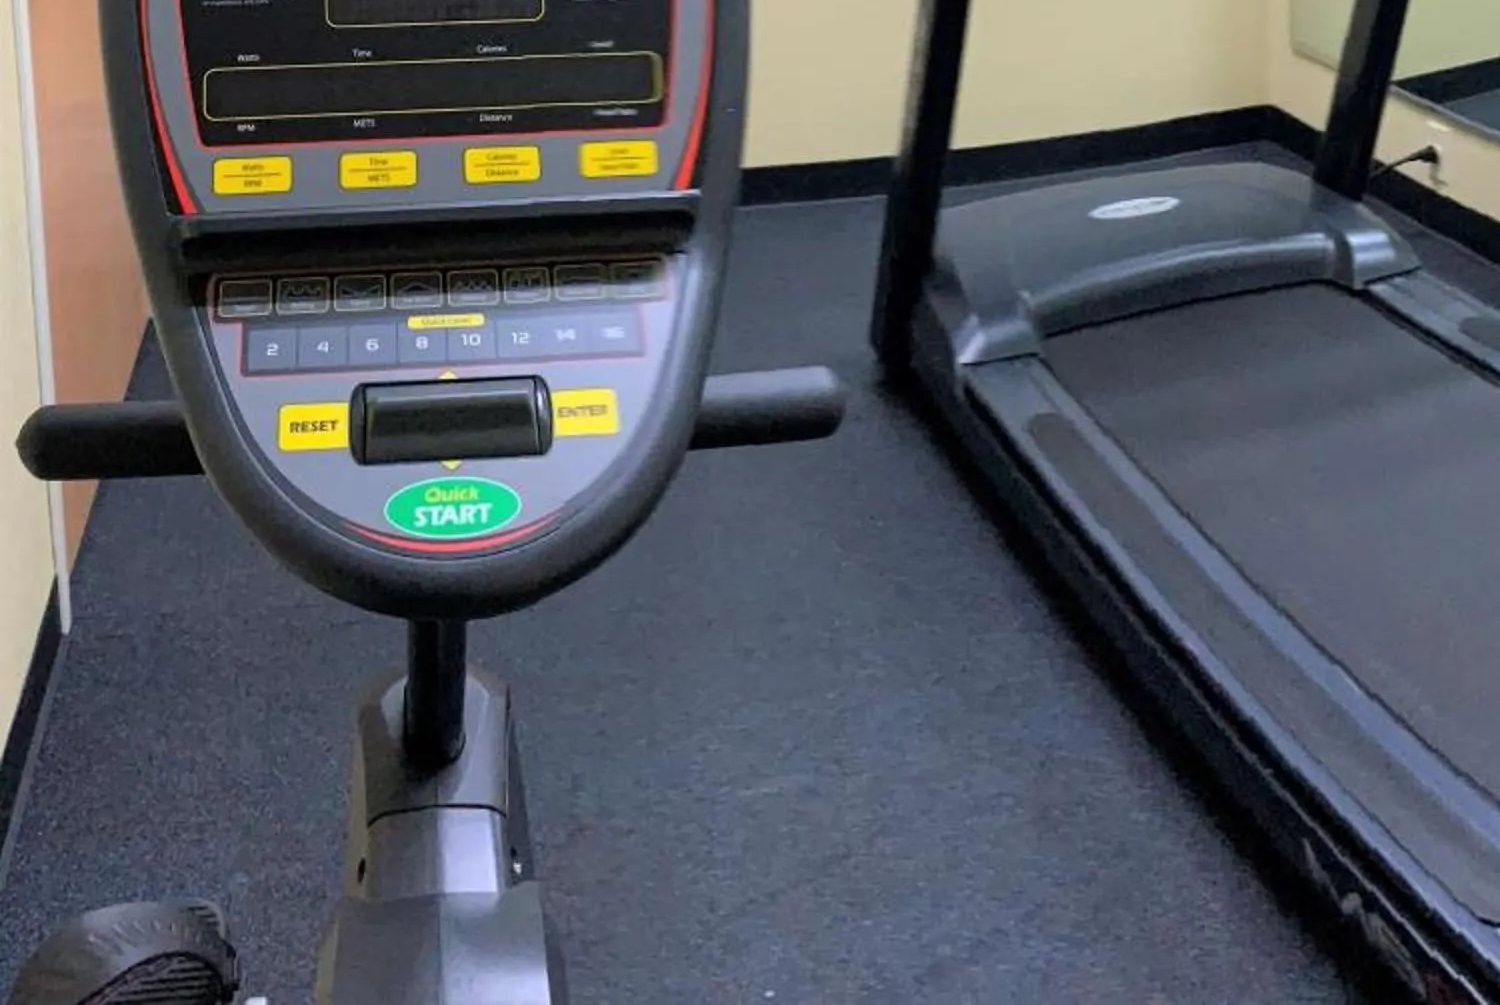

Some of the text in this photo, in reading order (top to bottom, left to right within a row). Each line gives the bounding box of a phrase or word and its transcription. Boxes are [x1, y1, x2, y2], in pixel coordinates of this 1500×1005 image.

[266, 343, 279, 356] 2
[316, 340, 330, 353] 4
[365, 338, 380, 352] 6
[415, 335, 429, 349] 8
[460, 333, 482, 346] 10
[511, 331, 530, 344] 12
[288, 419, 339, 434] RESET
[424, 485, 480, 503] Quick
[412, 502, 493, 527] START
